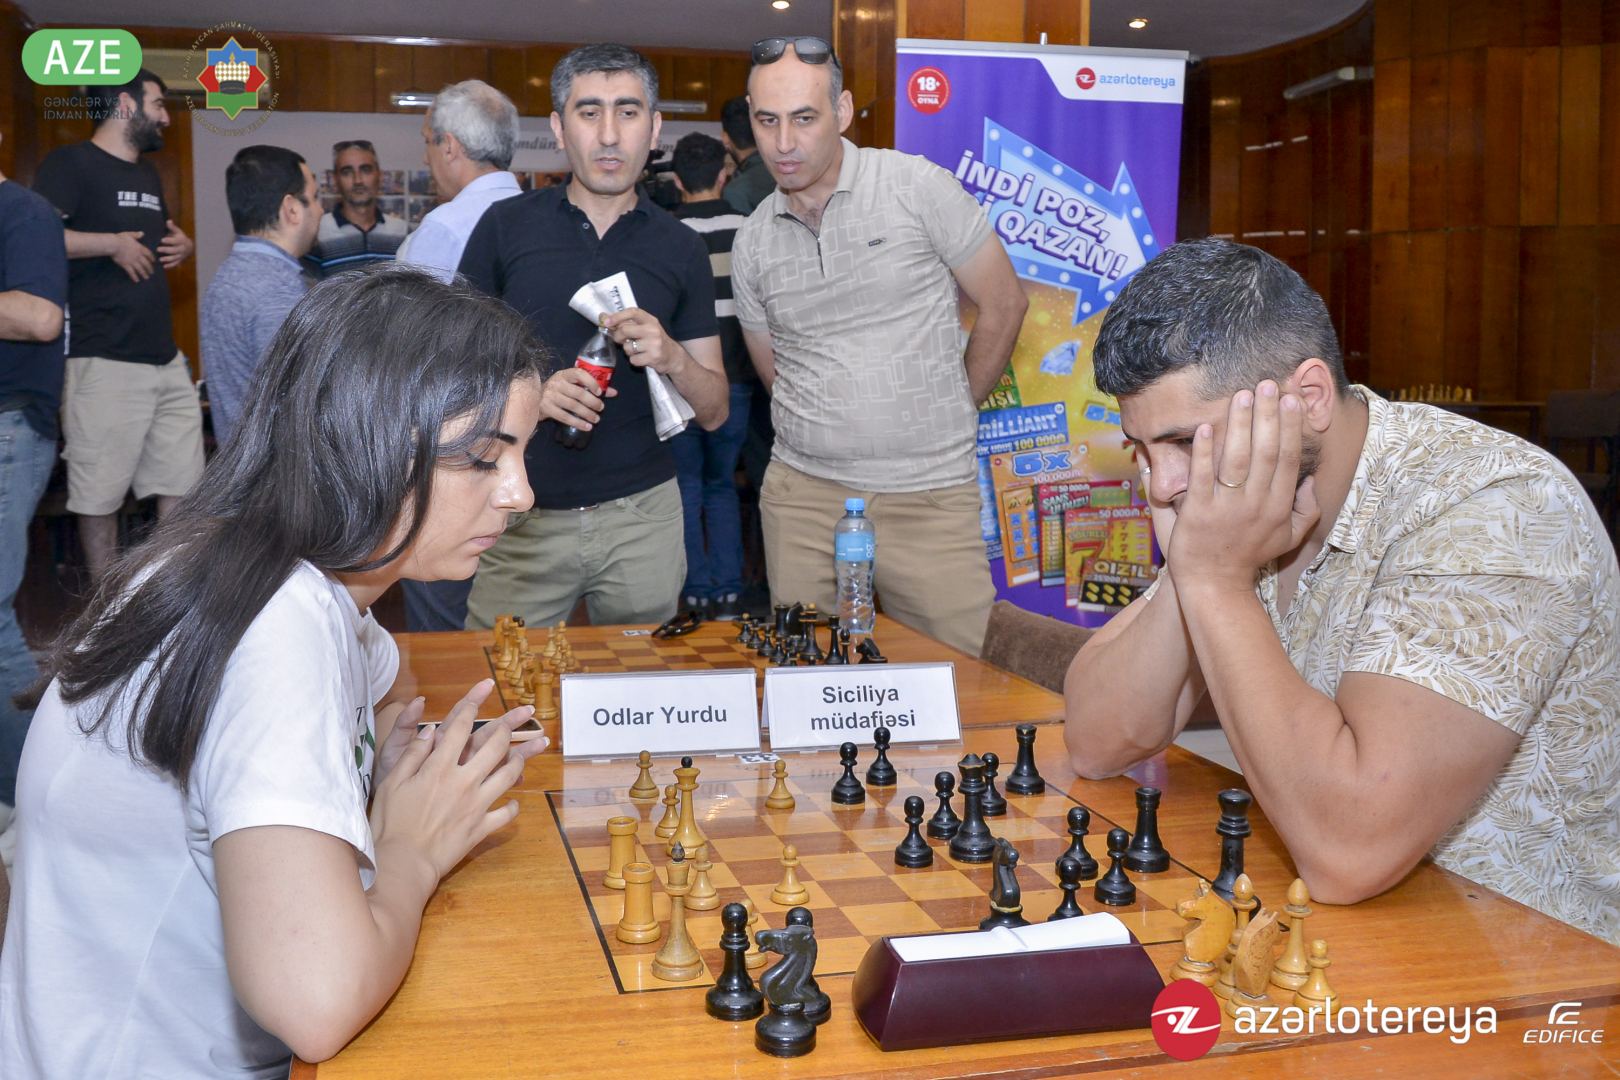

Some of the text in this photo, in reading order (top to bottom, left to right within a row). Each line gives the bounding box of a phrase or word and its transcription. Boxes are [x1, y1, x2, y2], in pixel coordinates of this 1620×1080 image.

[1099, 73, 1176, 89] azərlotereya
[955, 149, 1110, 243] İNDİ POZ,
[995, 210, 1128, 280] QAZAN!
[822, 685, 899, 706] Siciliya
[593, 705, 727, 726] Odlar Yurdu
[811, 709, 916, 730] müdafiəsi
